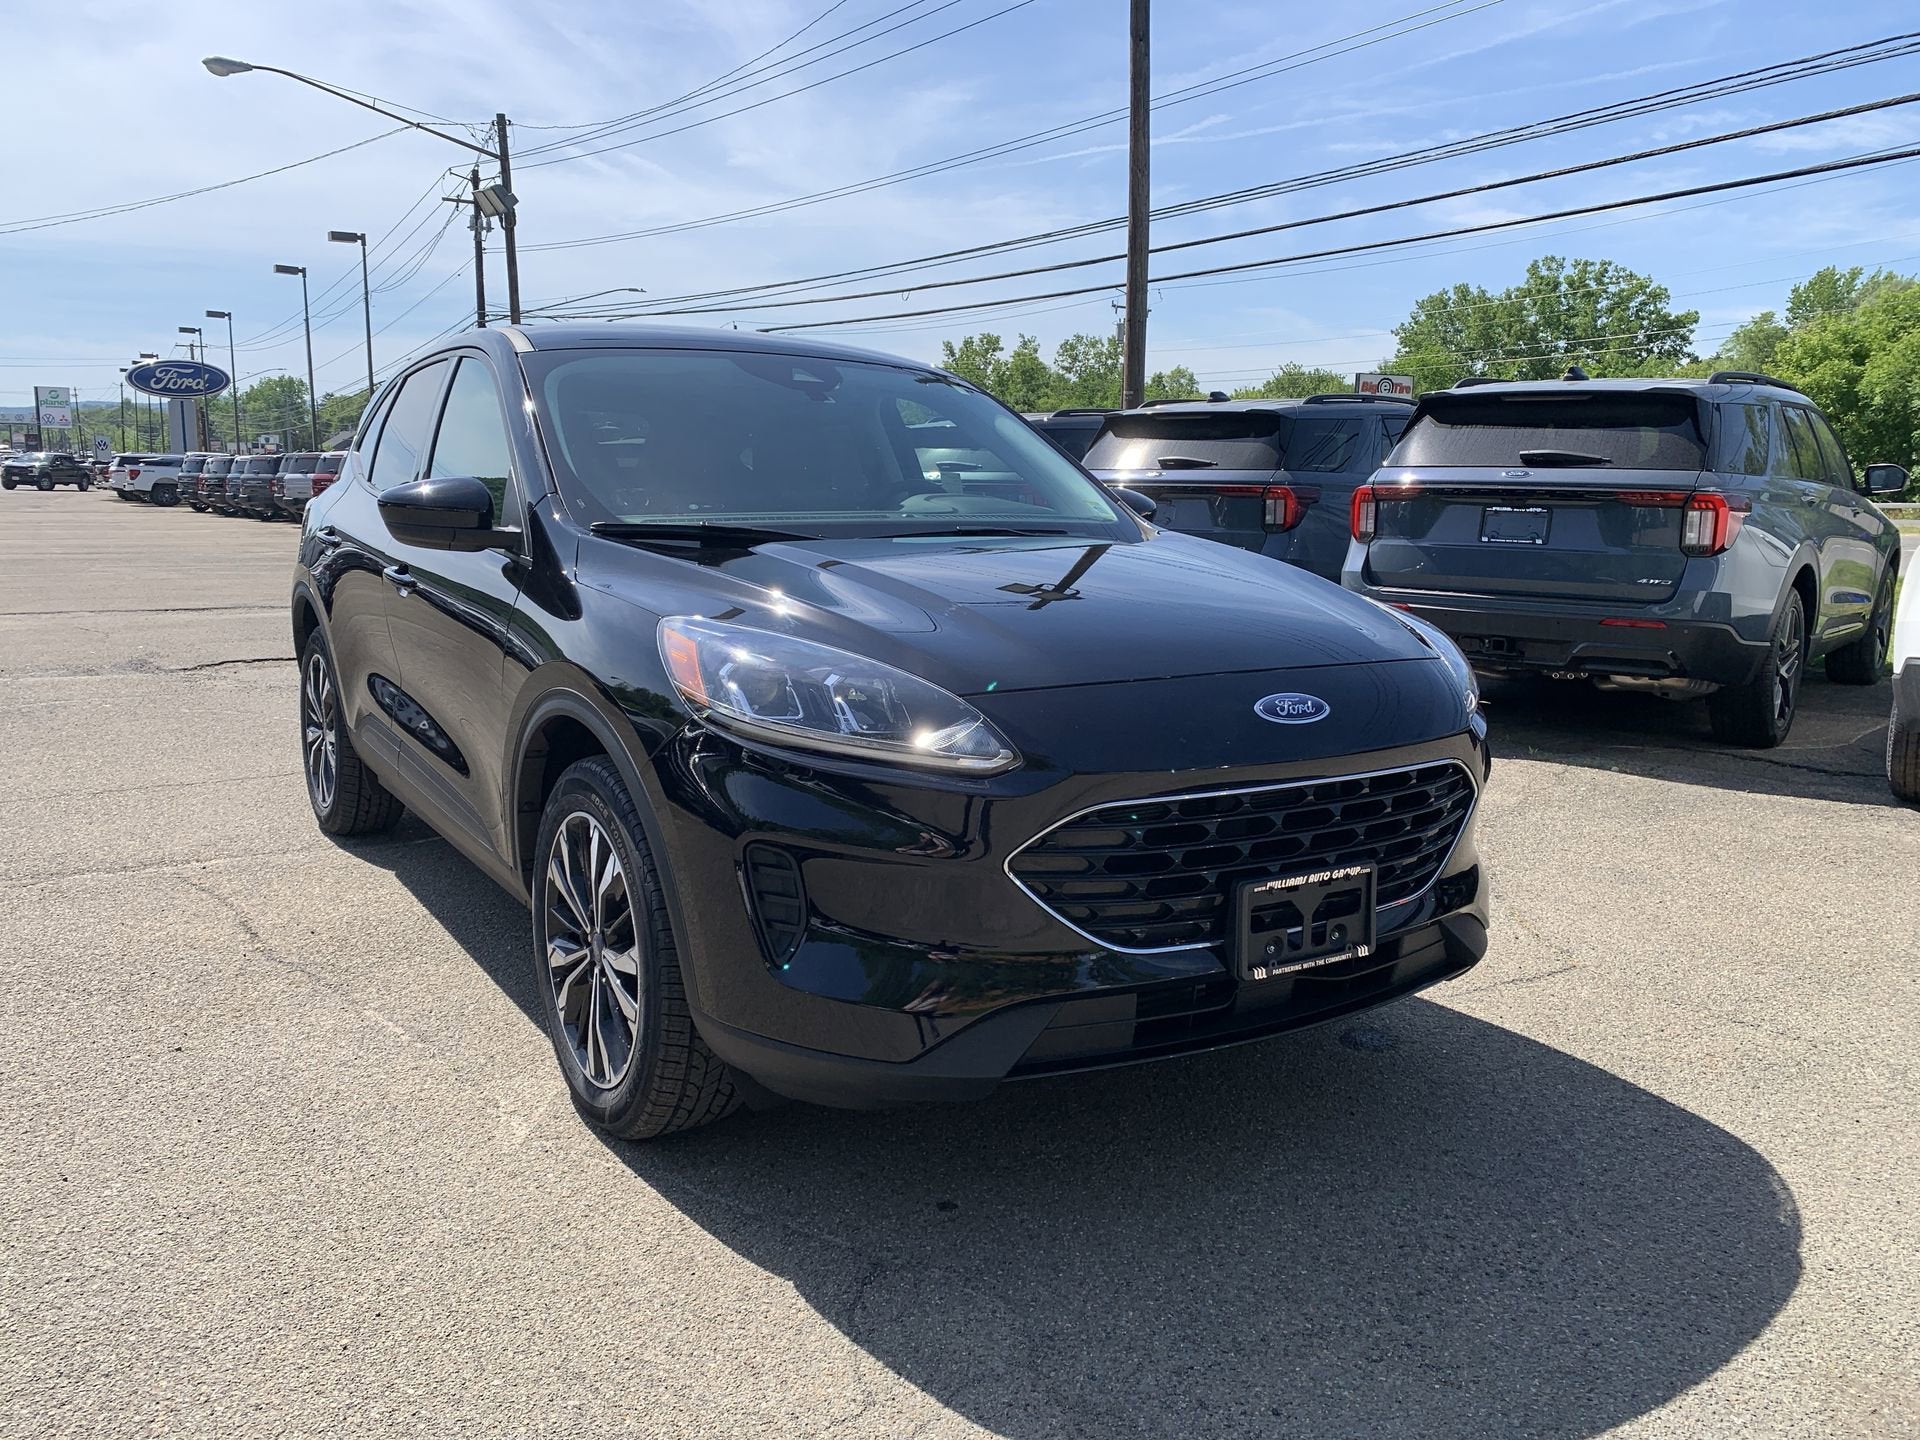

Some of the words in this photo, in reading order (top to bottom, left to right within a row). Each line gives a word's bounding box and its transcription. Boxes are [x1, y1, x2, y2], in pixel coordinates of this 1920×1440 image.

[150, 367, 210, 389] Ford
[1361, 381, 1377, 394] Big
[1275, 697, 1316, 716] Ford
[1308, 871, 1331, 883] AUTO
[1272, 963, 1303, 976] PARTNERING
[1302, 960, 1316, 969] WITH
[1315, 958, 1326, 967] THE
[1325, 952, 1353, 964] COMMUNITY
